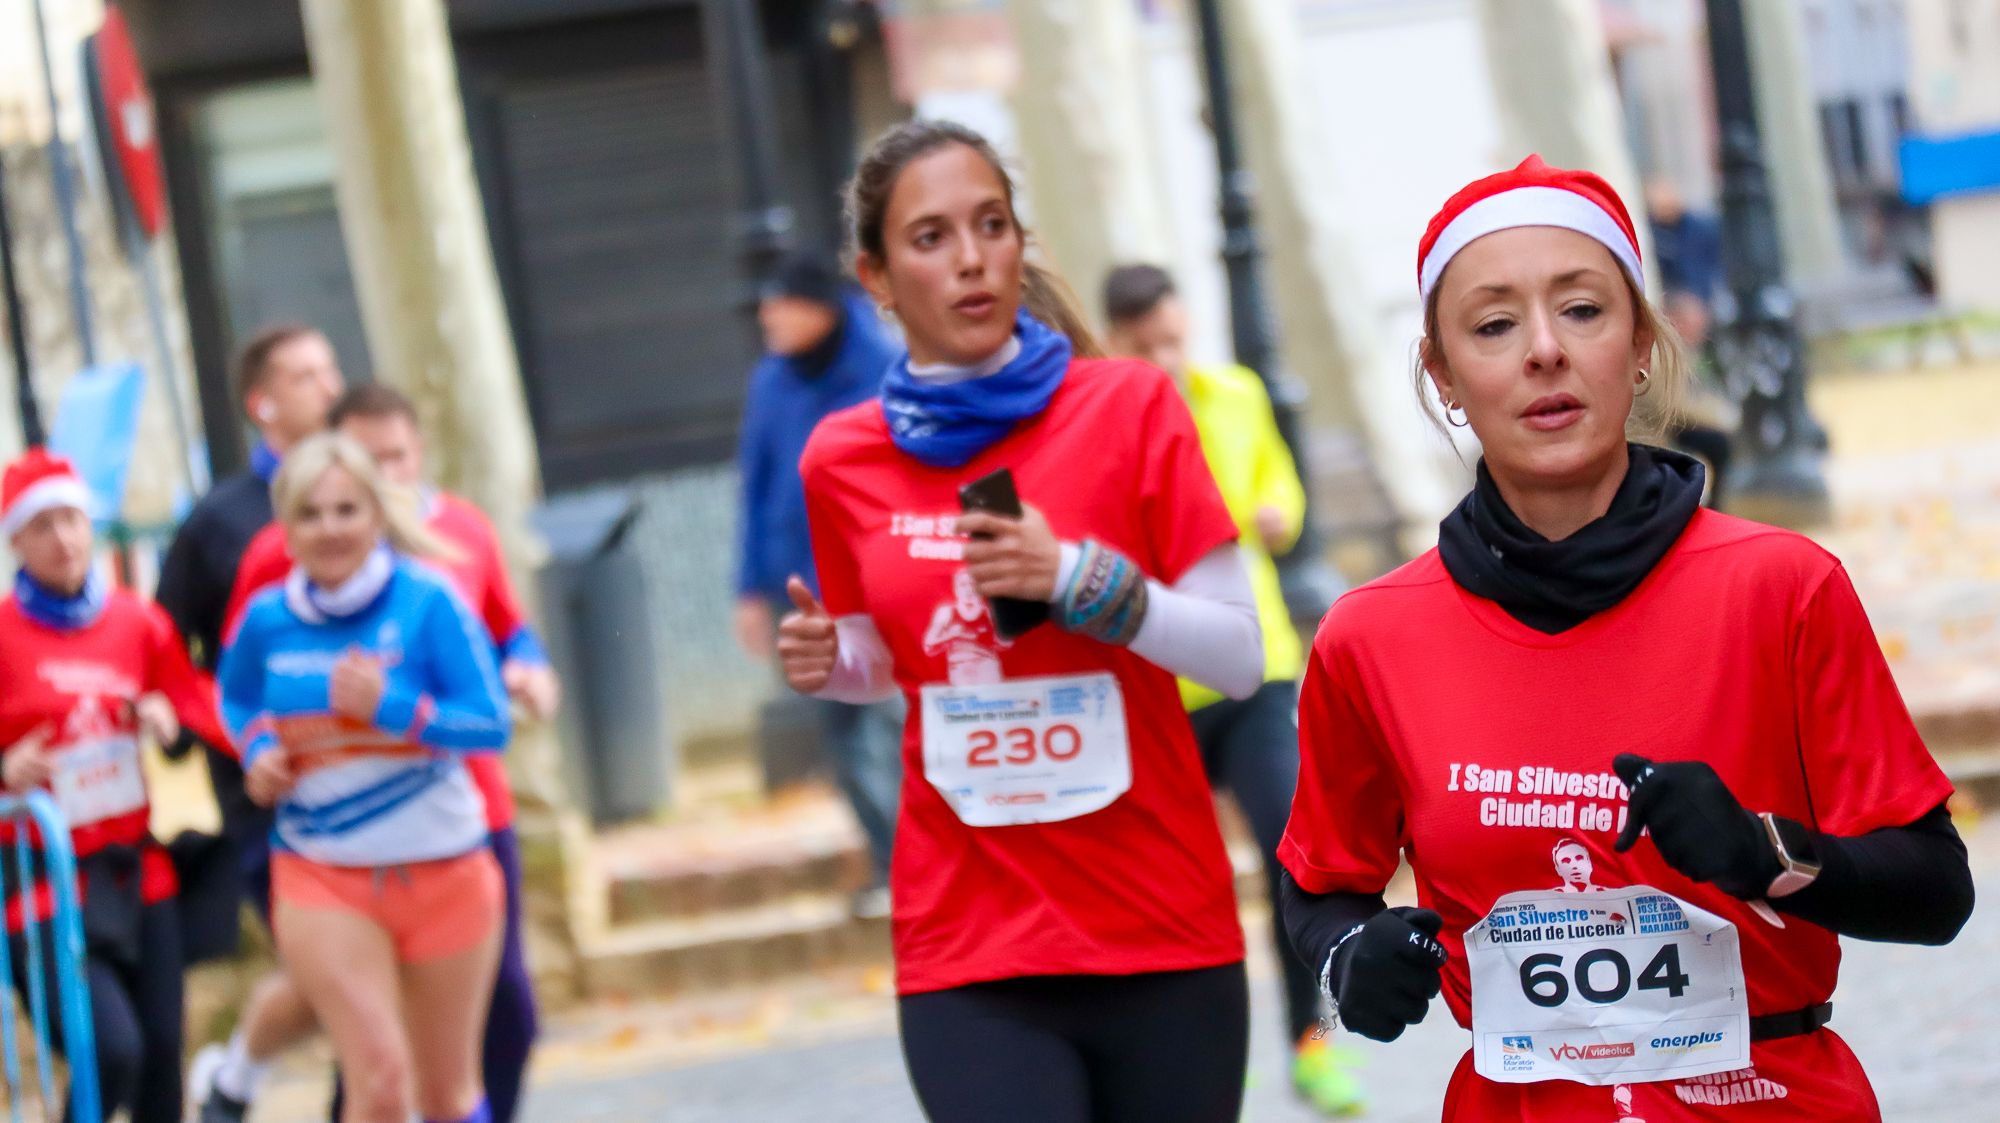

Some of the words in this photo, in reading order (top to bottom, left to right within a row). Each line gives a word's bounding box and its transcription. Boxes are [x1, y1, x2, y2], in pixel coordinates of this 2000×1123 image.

[966, 723, 1082, 769] 230
[1447, 763, 1461, 791] I
[1464, 763, 1513, 793] San
[1480, 797, 1575, 829] Ciudad
[1579, 803, 1613, 832] de
[1488, 914, 1516, 928] San
[1518, 908, 1589, 926] Silvestre
[1639, 911, 1682, 924] HURTADO
[1640, 920, 1690, 934] MARJALIZO
[1490, 927, 1542, 944] Ciudad
[1545, 926, 1564, 940] de
[1568, 923, 1625, 939] Lucena
[1519, 943, 1690, 1008] 604
[1650, 1032, 1724, 1048] enerplus
[1591, 1045, 1631, 1057] videoluc
[1674, 1078, 1788, 1106] MARJALIZO
